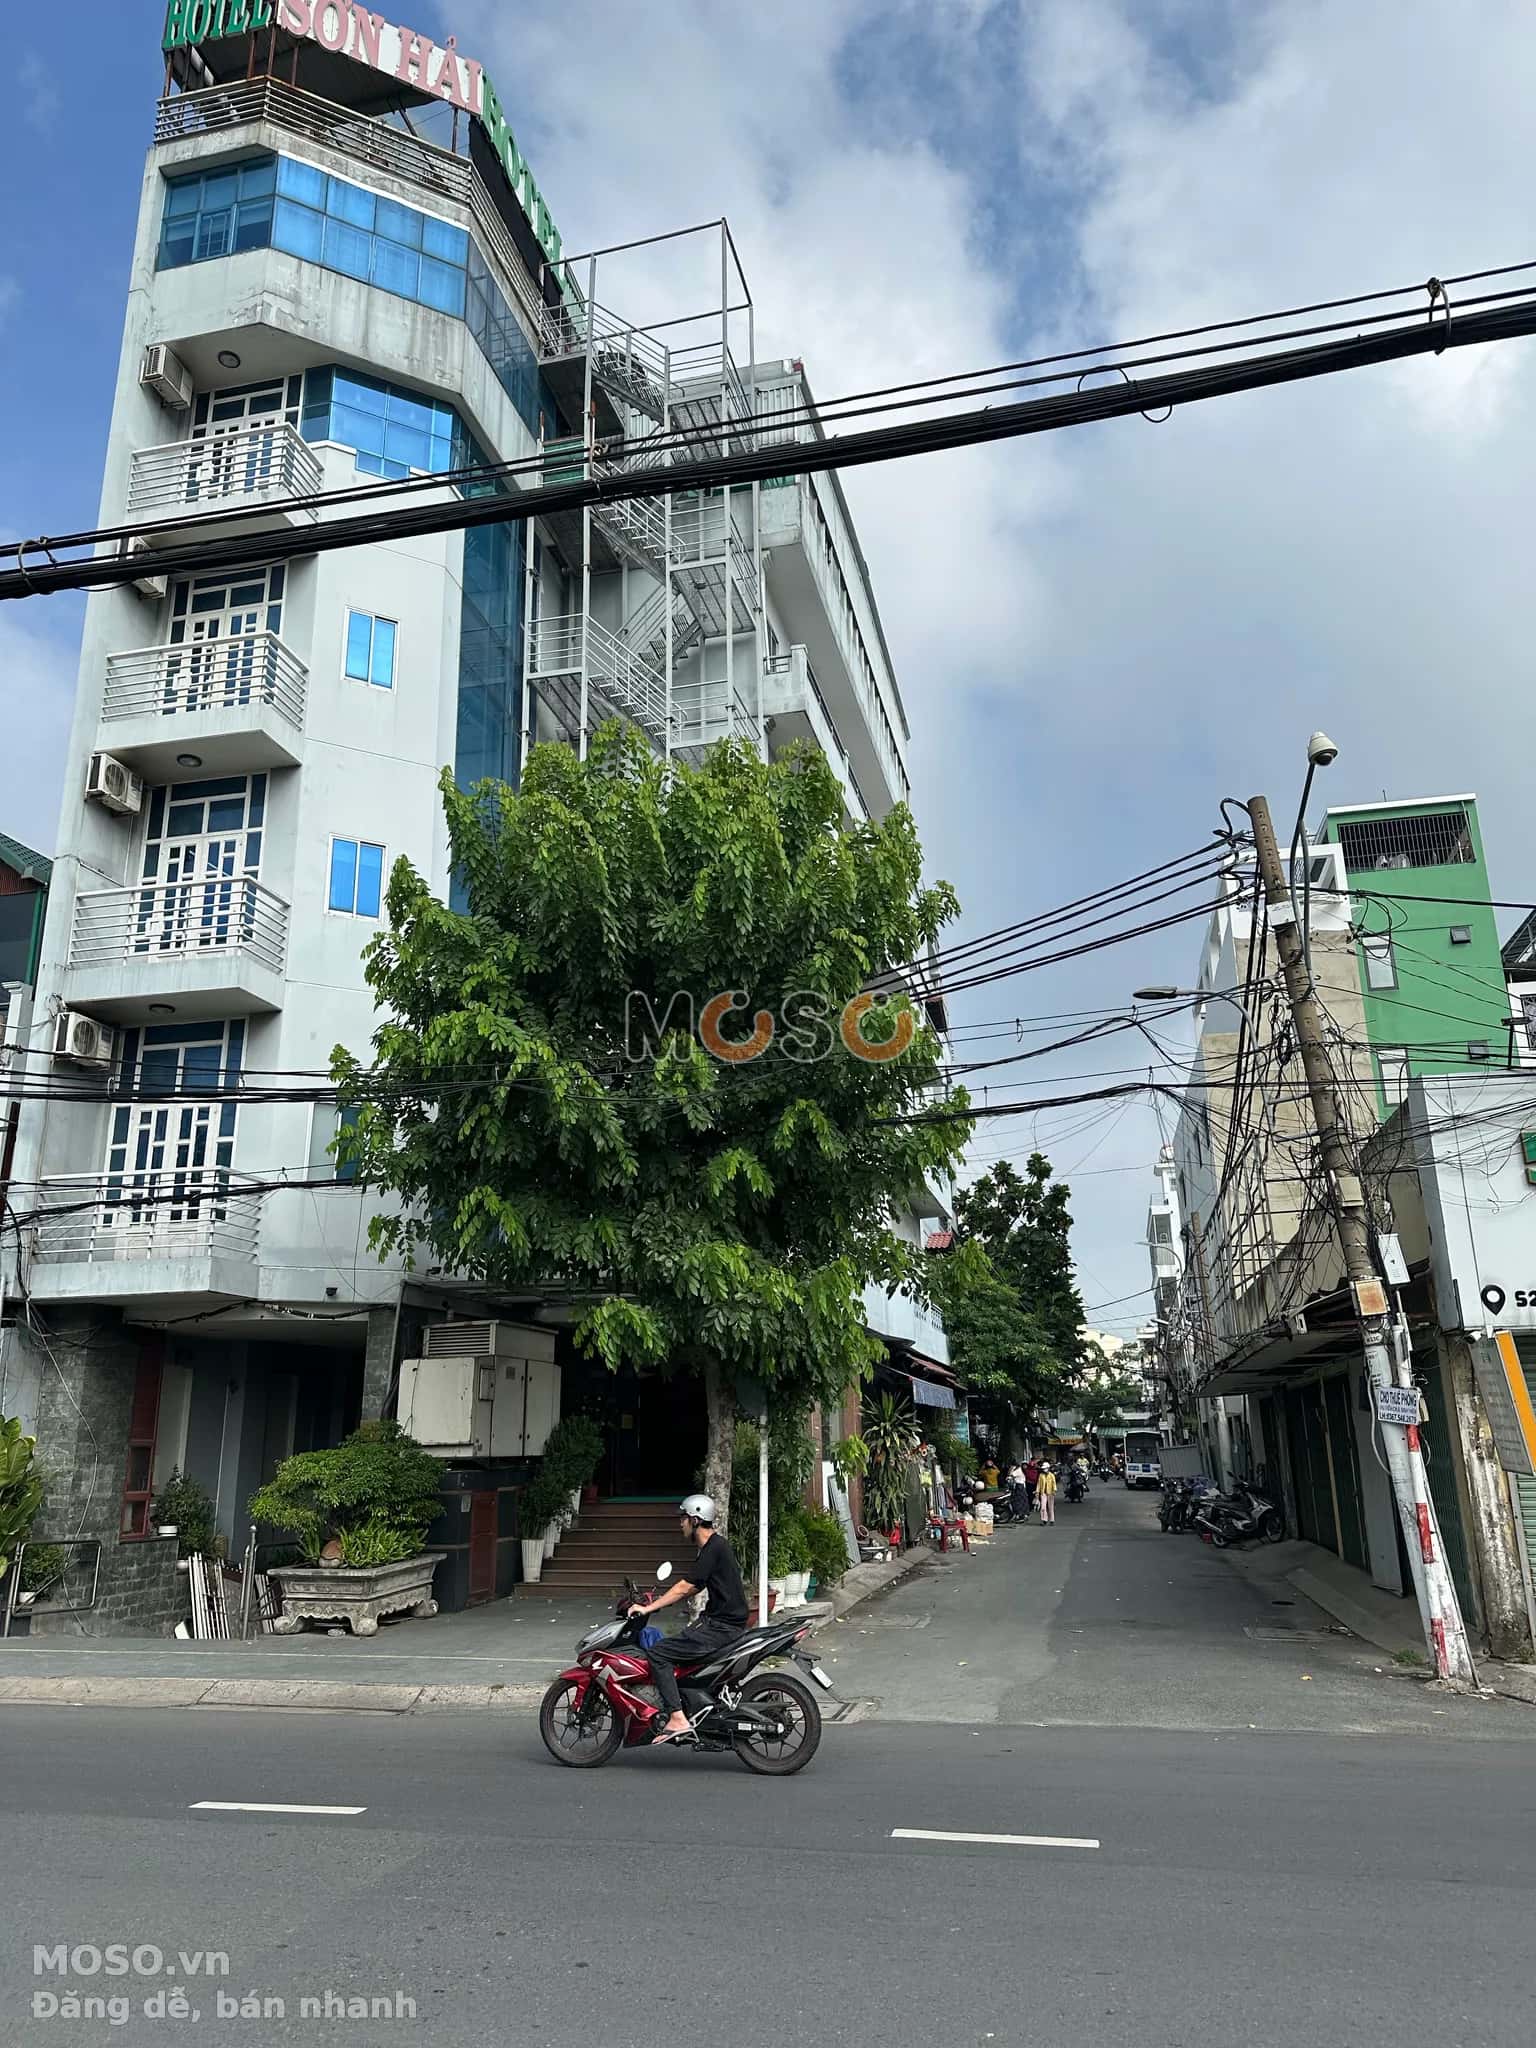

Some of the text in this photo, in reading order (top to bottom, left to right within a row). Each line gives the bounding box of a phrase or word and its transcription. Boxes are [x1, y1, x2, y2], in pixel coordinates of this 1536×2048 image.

[162, 0, 271, 49] HOTEL
[279, 0, 482, 112] SƠN HẢI
[1379, 1390, 1389, 1404] CHO
